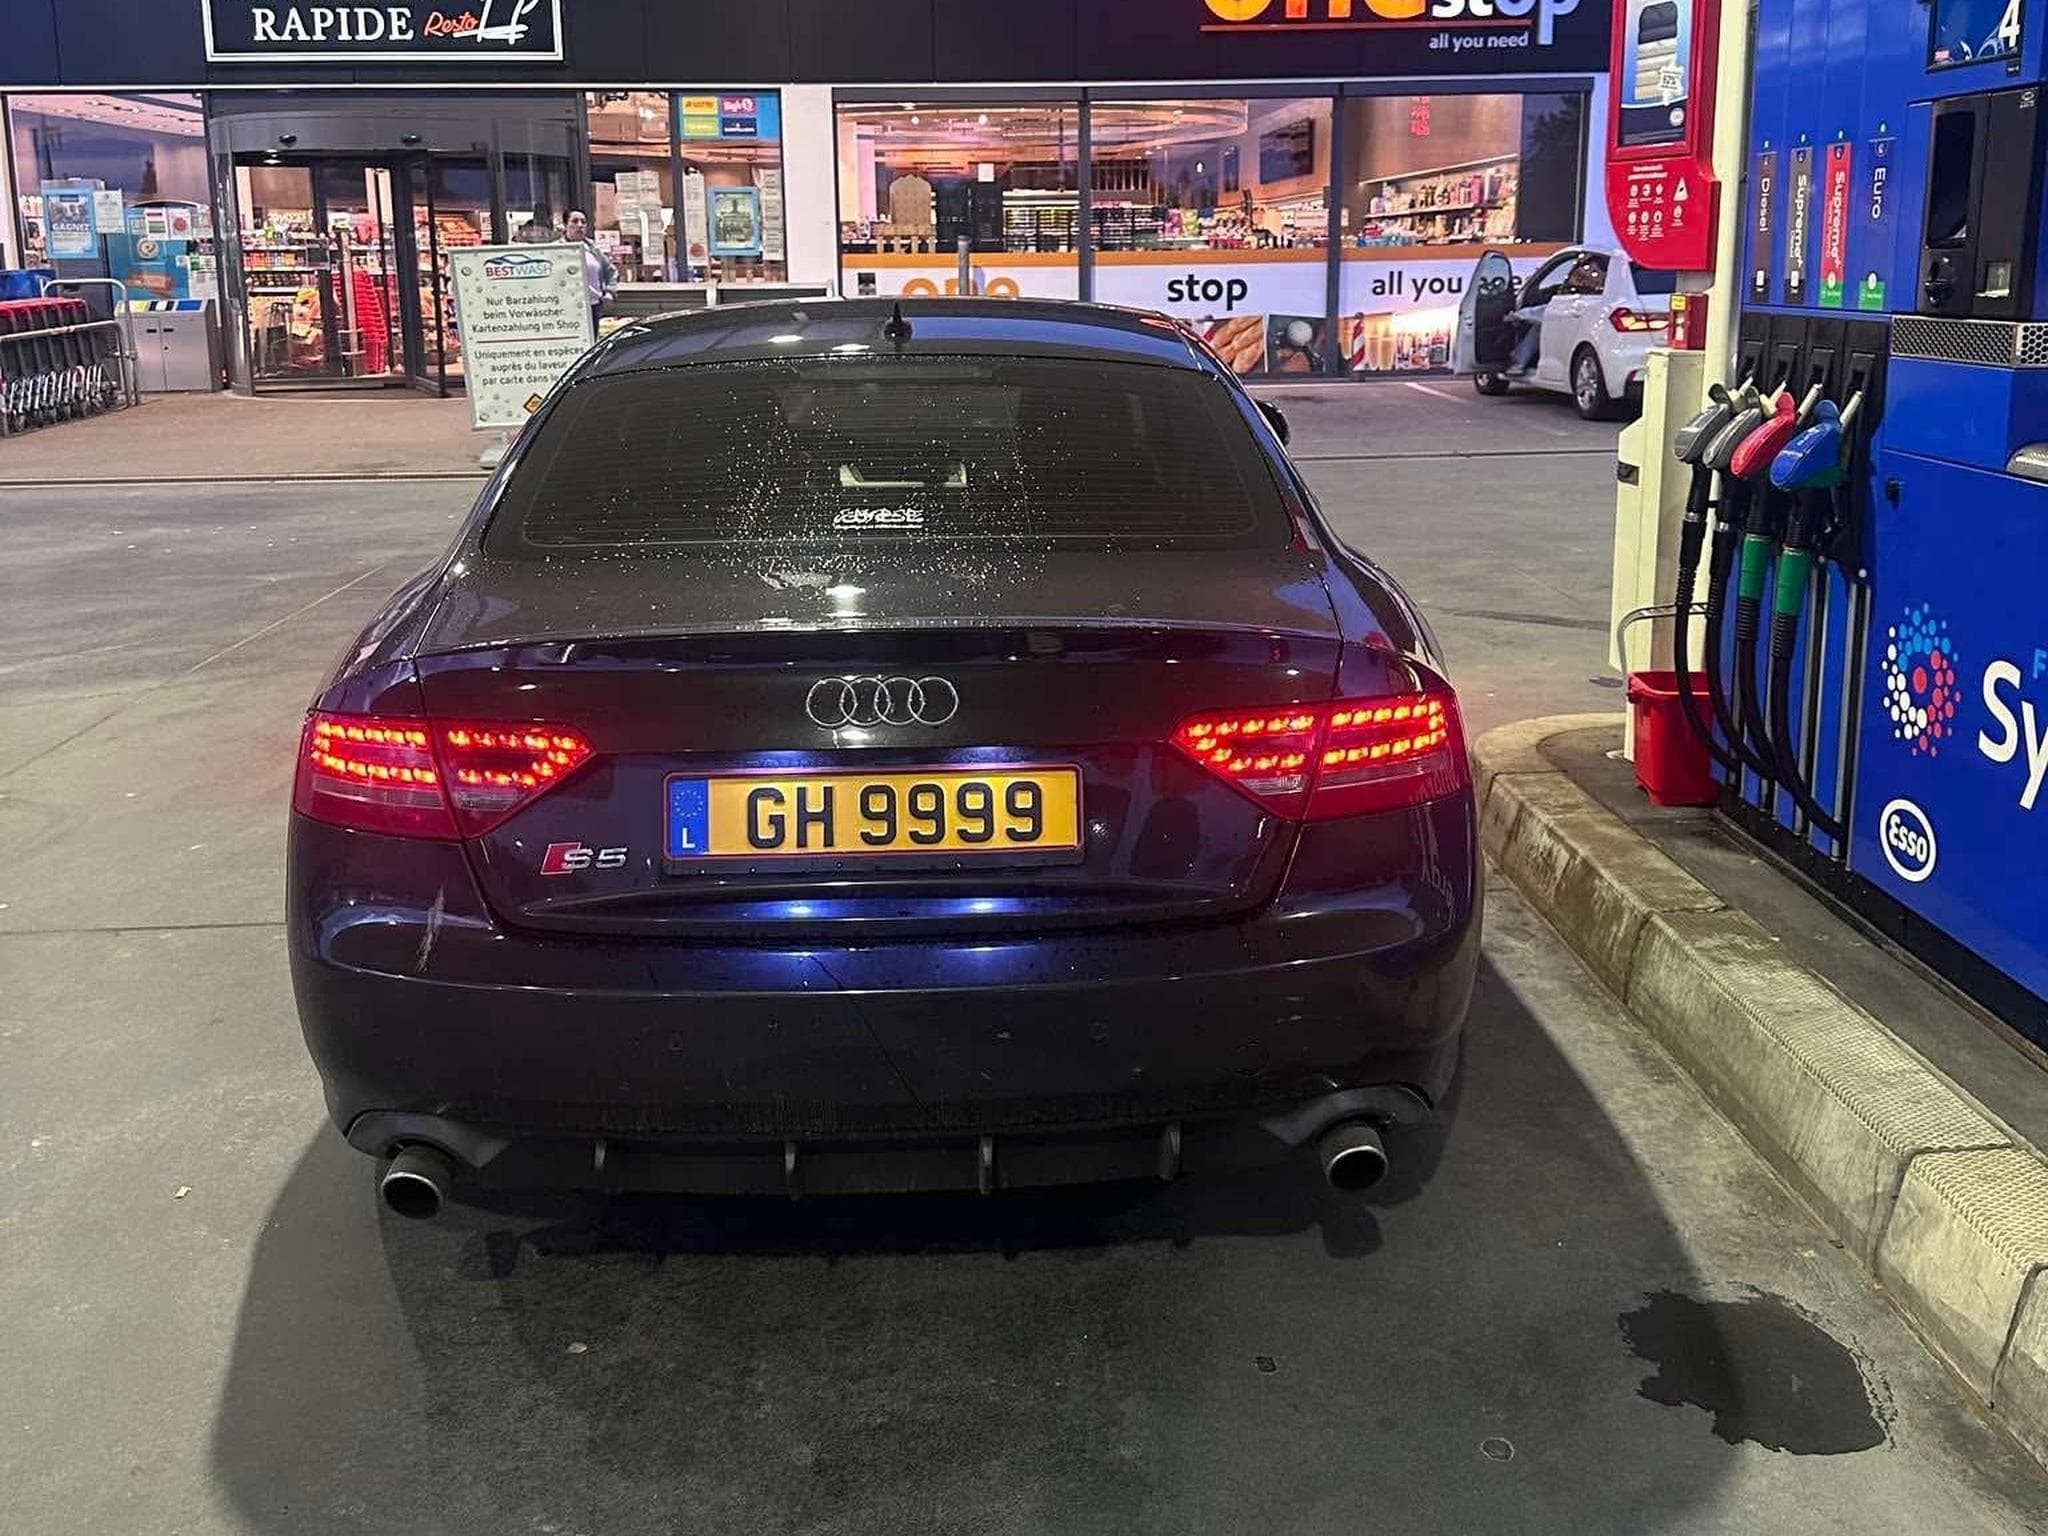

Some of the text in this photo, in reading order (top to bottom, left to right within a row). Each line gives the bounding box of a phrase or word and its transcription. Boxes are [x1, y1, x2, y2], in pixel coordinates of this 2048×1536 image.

[252, 7, 415, 42] RAPIDE
[424, 11, 479, 37] Resto
[1429, 32, 1529, 52] all you need
[1871, 167, 1887, 219] Euro
[1759, 177, 1771, 232] Diesel
[1166, 273, 1248, 311] stop
[1372, 270, 1402, 296] all
[1411, 275, 1462, 301] you
[486, 295, 559, 306] Nur Barzahlung
[472, 320, 580, 333] Kartenzahlung im Shop
[483, 311, 507, 320] beim
[474, 349, 532, 360] Uniquement
[533, 350, 546, 358] en
[491, 363, 522, 373] auprès
[525, 362, 537, 371] du
[482, 378, 498, 387] par
[500, 375, 524, 385] carte
[526, 373, 549, 383] dans
[747, 781, 1043, 850] GH 9999
[681, 827, 696, 849] L
[561, 848, 628, 870] S5
